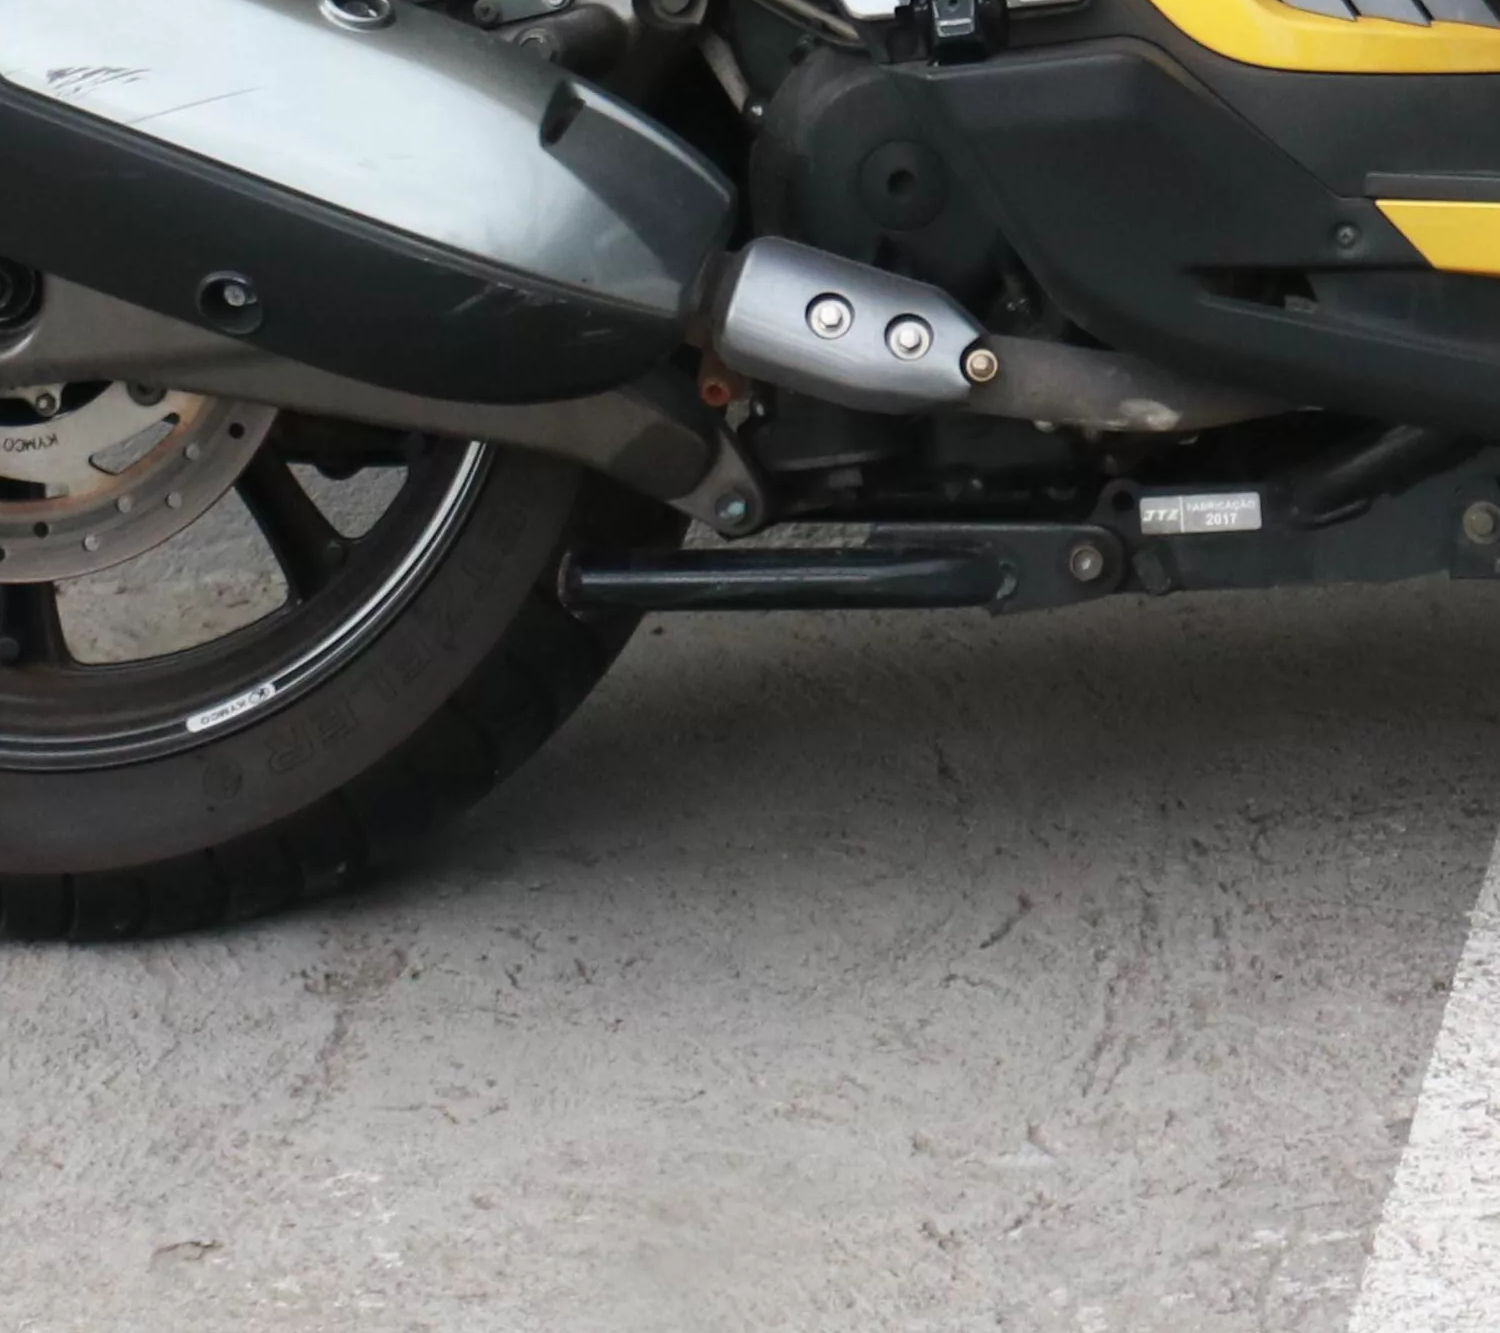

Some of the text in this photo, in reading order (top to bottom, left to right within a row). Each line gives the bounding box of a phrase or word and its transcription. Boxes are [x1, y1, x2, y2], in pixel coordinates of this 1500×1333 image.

[2, 433, 59, 453] KYMCO
[1205, 512, 1238, 526] 2017
[200, 700, 247, 726] KYMCO
